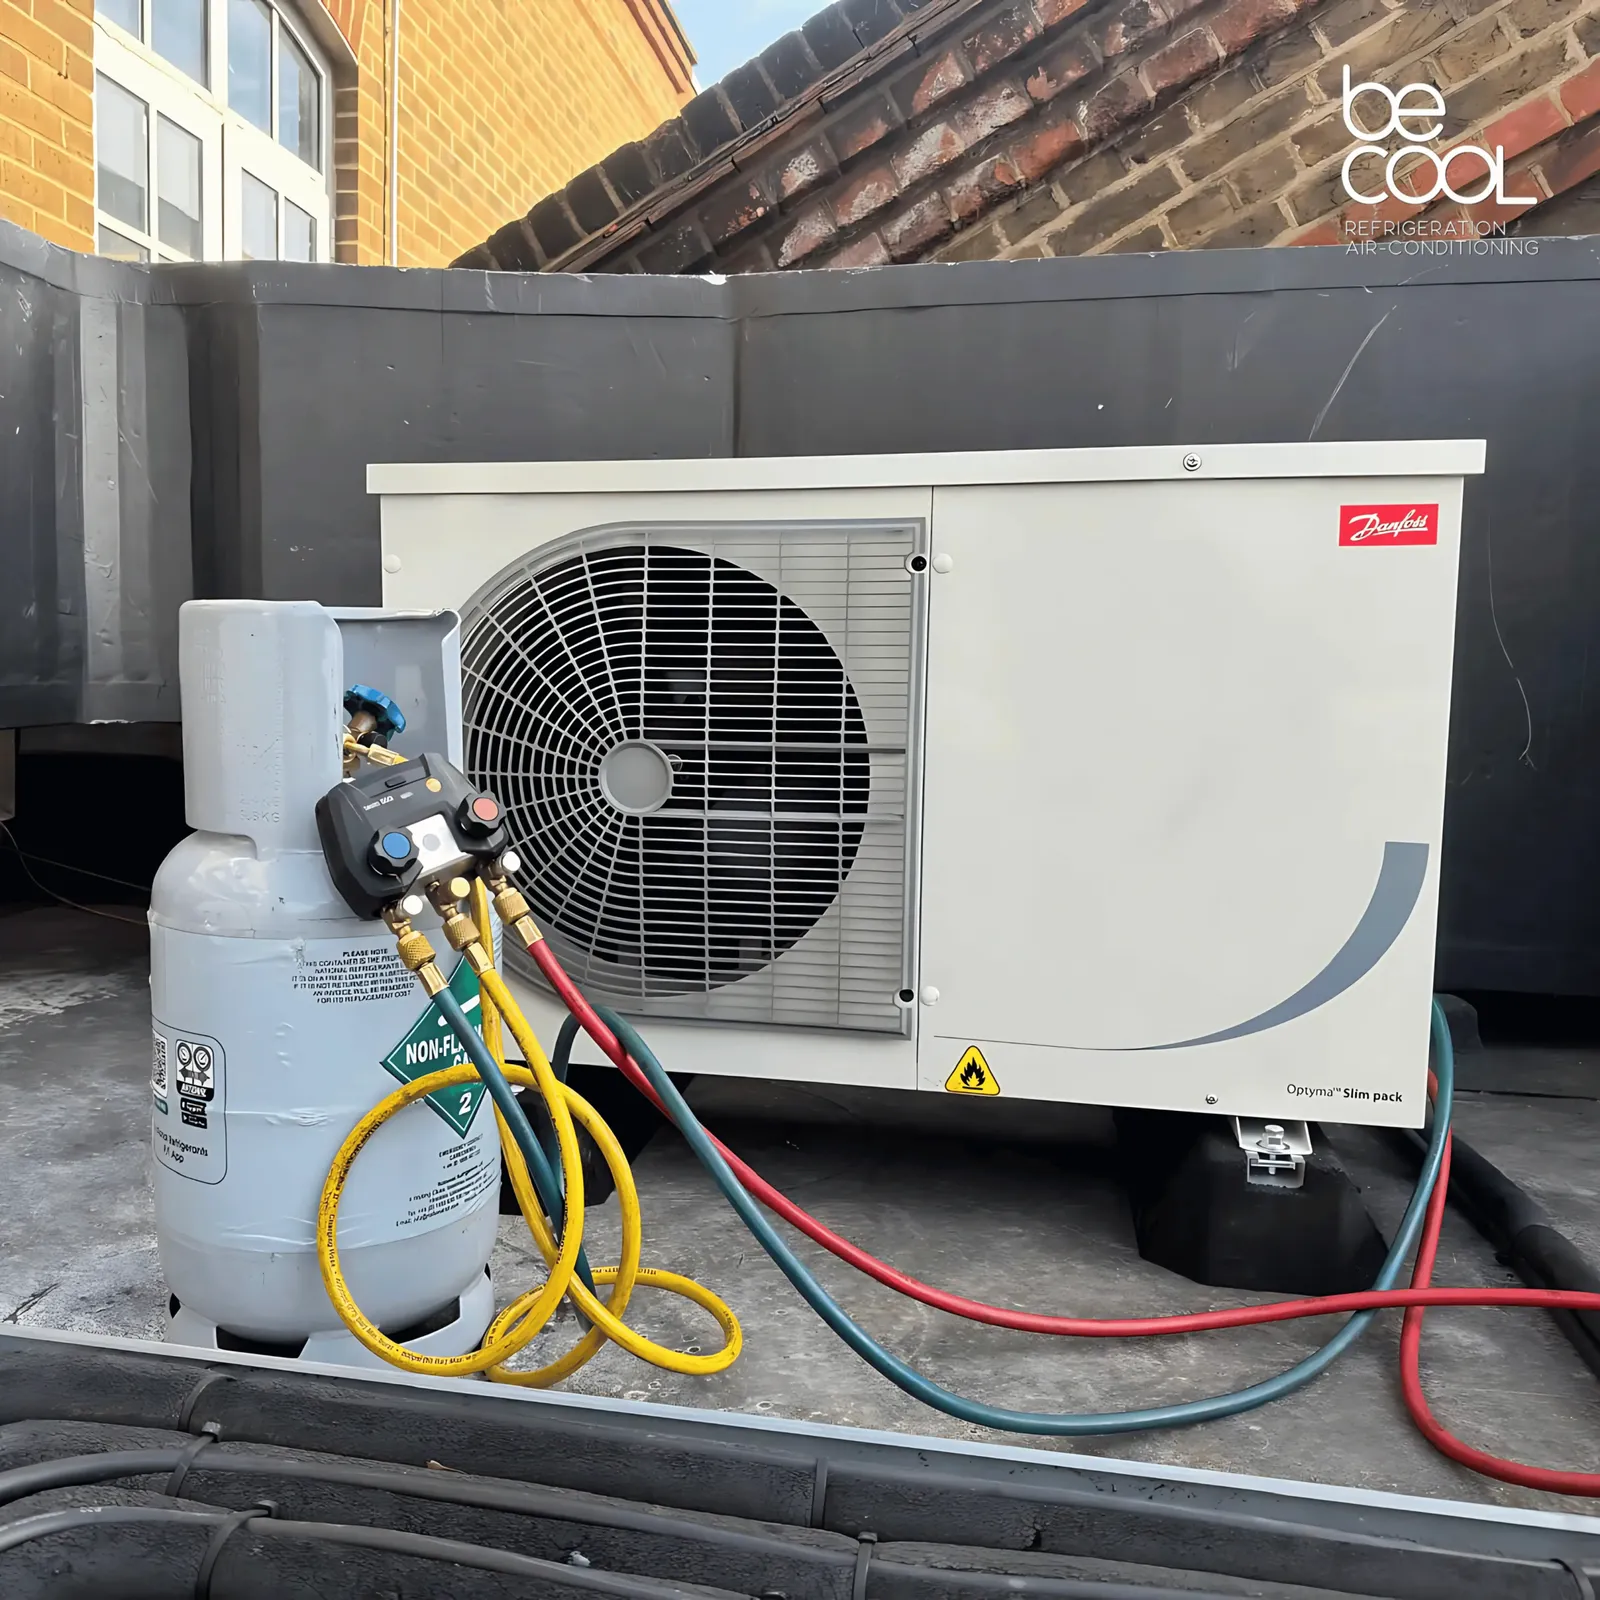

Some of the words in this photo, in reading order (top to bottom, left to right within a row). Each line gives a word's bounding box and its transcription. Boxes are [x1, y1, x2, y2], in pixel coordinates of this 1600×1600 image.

[1348, 509, 1429, 541] Danfoss
[458, 1092, 472, 1115] 2
[1343, 1088, 1370, 1099] Slim
[1372, 1092, 1403, 1102] pack
